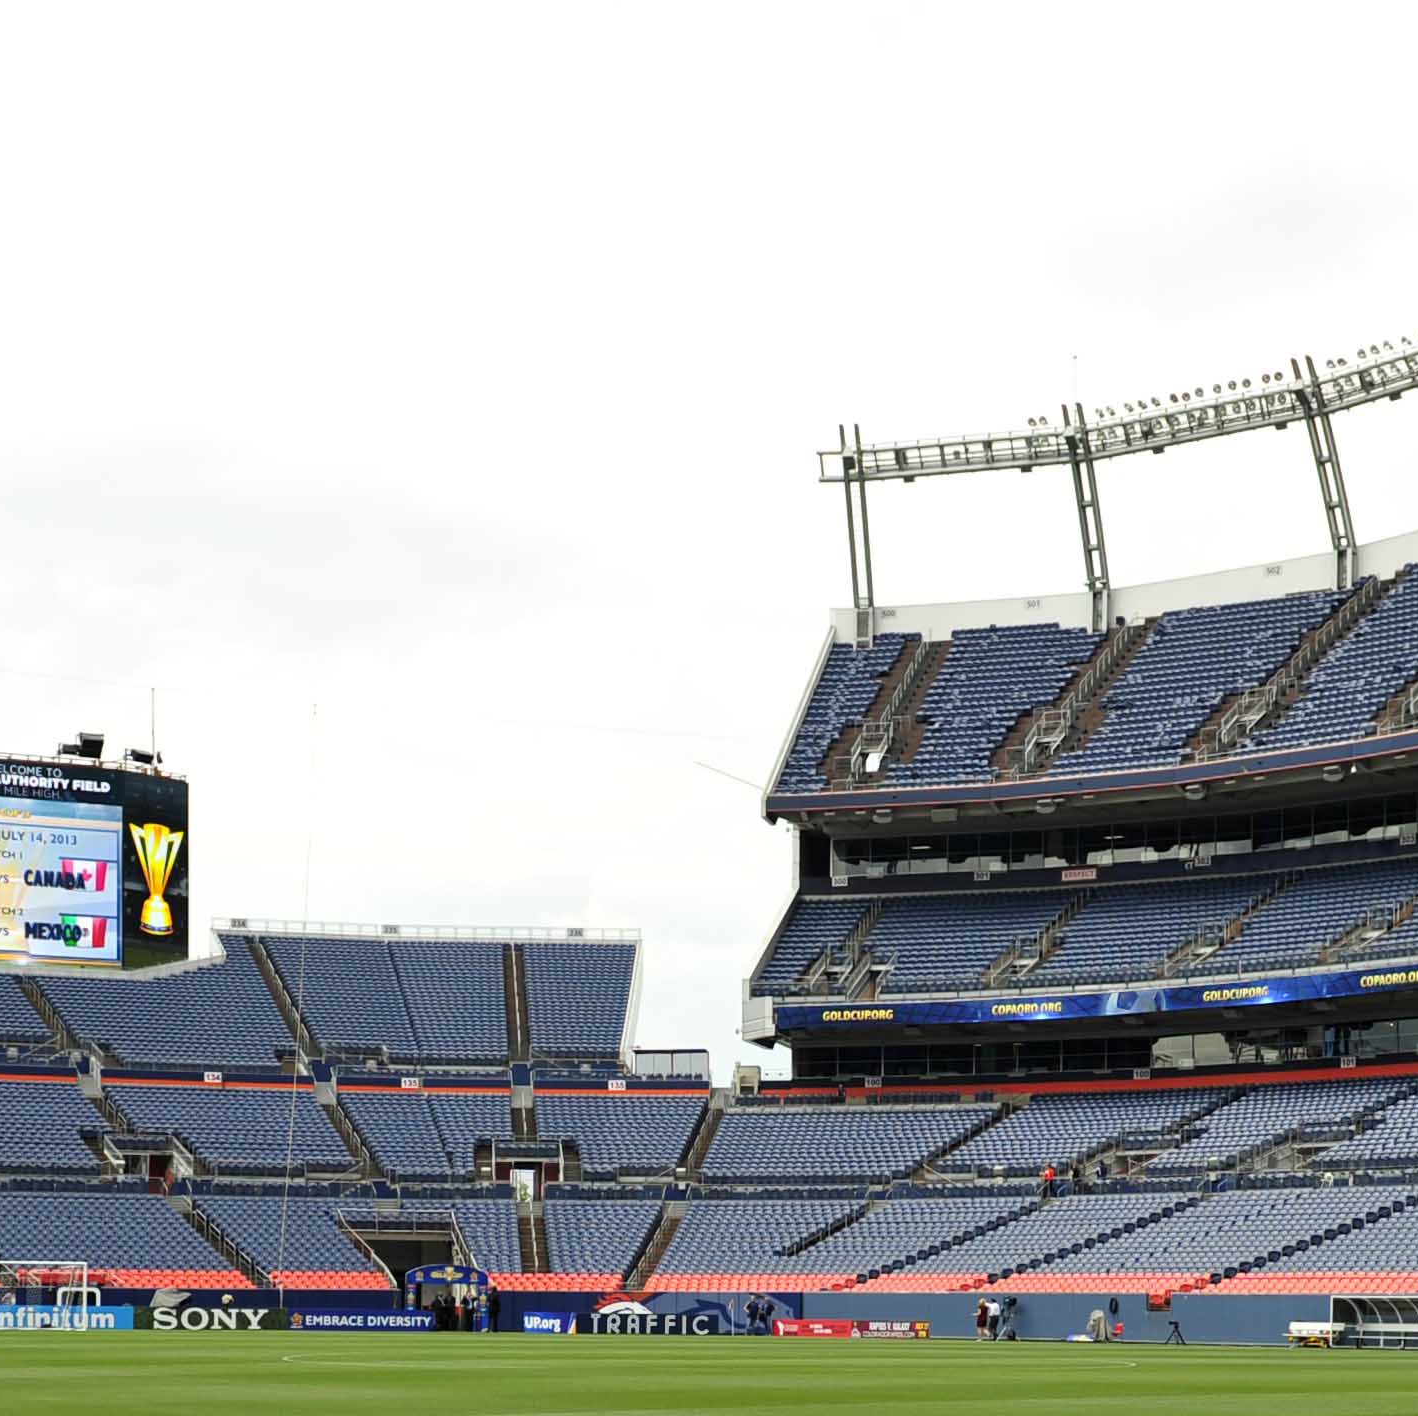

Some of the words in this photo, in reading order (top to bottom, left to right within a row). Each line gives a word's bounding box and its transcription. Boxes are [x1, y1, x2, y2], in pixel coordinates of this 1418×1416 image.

[46, 766, 62, 778] TO
[4, 787, 29, 799] MILE
[72, 779, 111, 793] FIELD
[50, 833, 78, 847] 2013
[23, 869, 86, 890] CANADA
[24, 921, 82, 942] MEXICO
[1341, 1056, 1356, 1068] 101
[152, 1306, 270, 1331] SONY
[305, 1314, 364, 1328] EMBRACE
[367, 1315, 432, 1328] DIVERSITY
[524, 1315, 562, 1333] UP.org
[590, 1313, 710, 1335] TRAFFIC
